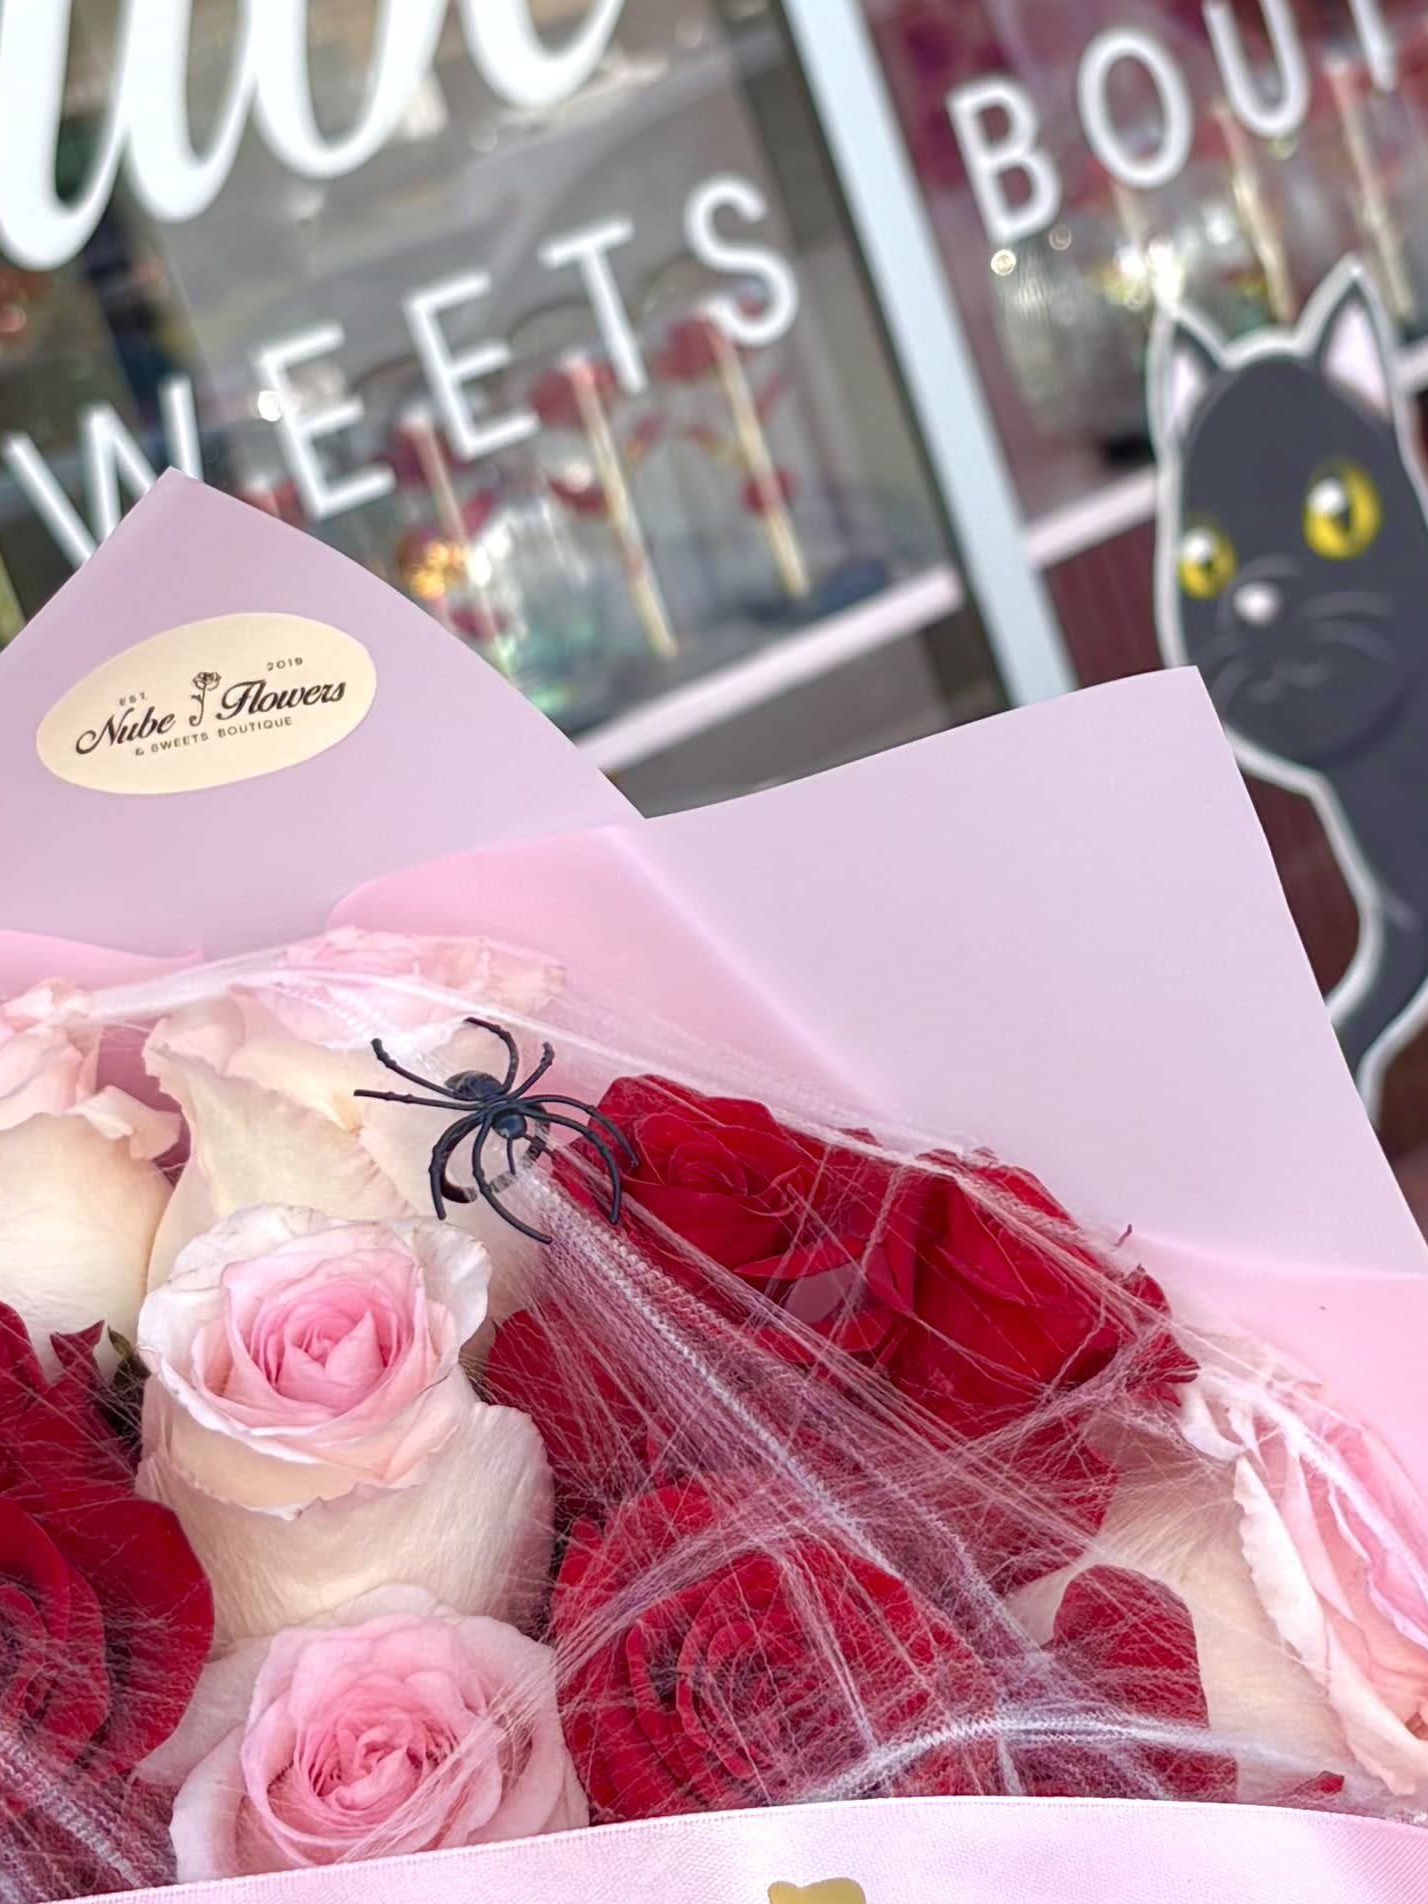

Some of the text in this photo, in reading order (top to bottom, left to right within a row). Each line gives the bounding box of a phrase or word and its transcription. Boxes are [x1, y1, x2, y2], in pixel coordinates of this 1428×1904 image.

[267, 656, 304, 672] 2019
[75, 679, 346, 755] Nube Flowers
[151, 731, 209, 754] SWEETS
[218, 715, 293, 738] BOUTIQUE
